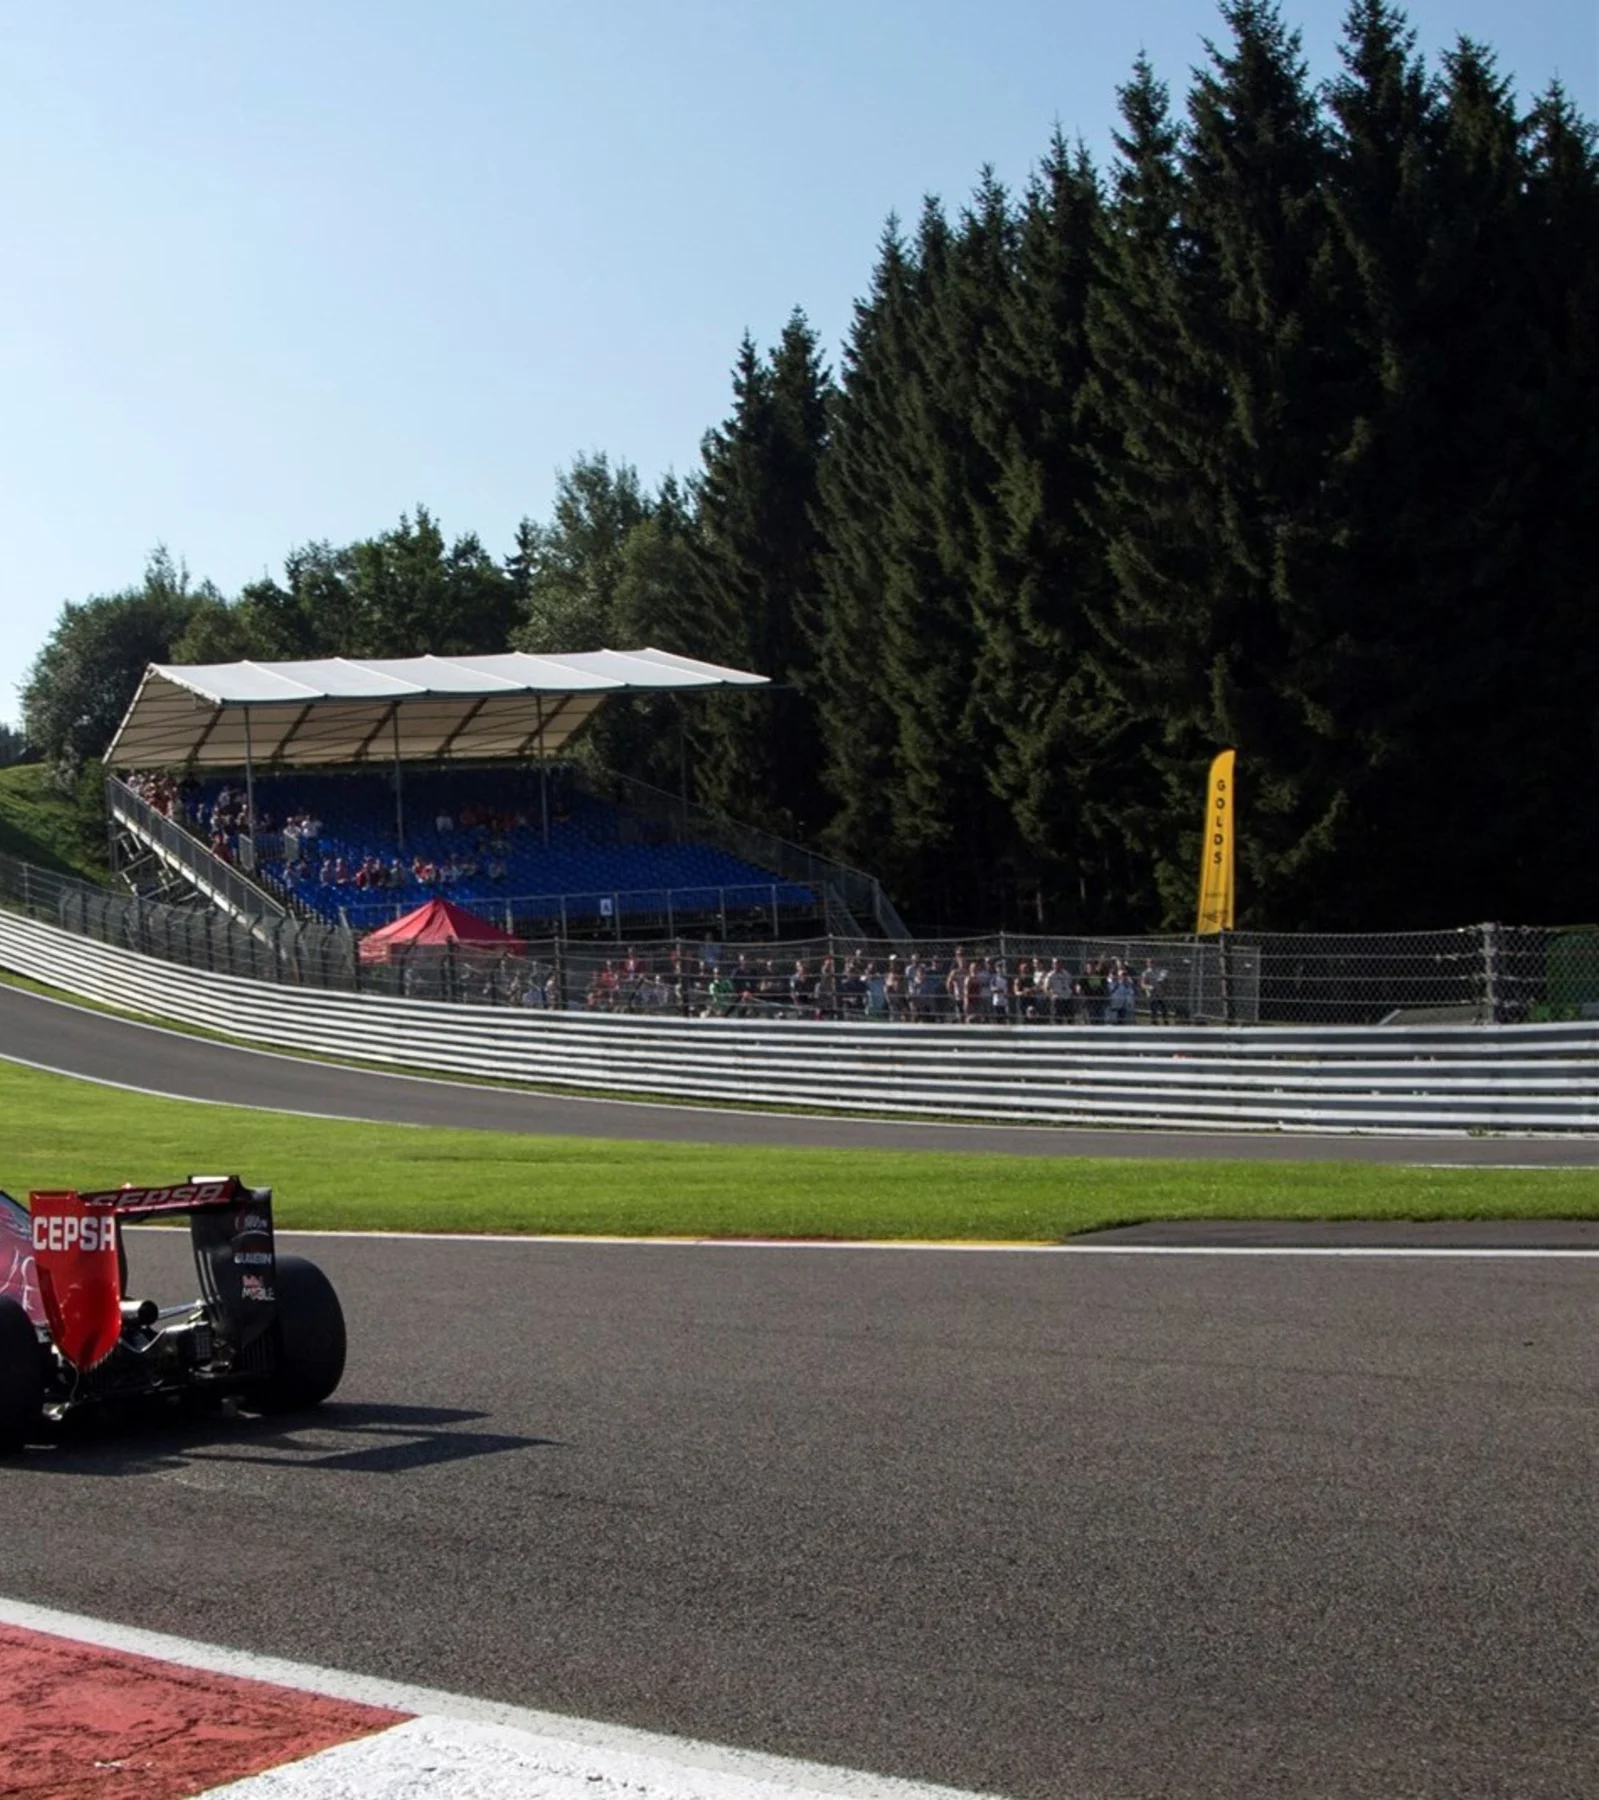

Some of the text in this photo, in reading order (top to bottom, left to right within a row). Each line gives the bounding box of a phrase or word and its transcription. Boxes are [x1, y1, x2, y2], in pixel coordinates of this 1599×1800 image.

[1213, 779, 1227, 865] GOLDS
[92, 1184, 224, 1207] CEPSA
[32, 1216, 116, 1251] CEPSA
